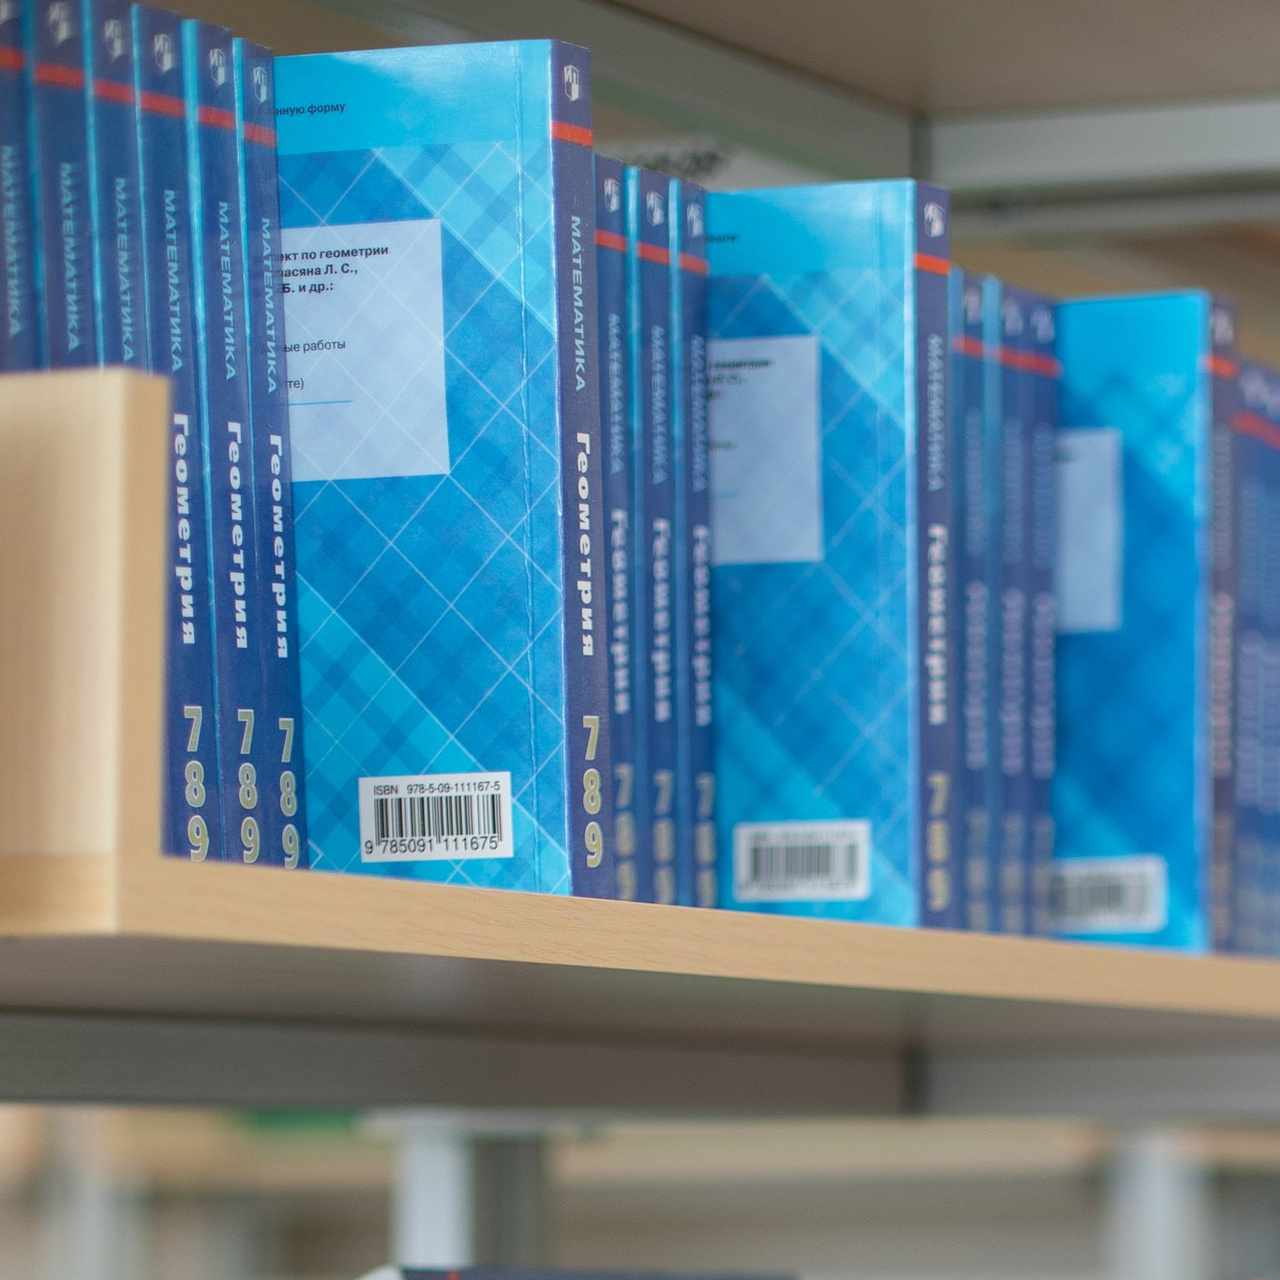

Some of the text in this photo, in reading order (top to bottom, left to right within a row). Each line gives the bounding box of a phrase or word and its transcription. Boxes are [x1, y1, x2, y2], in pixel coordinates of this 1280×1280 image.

[276, 102, 346, 117] нную форму
[302, 250, 315, 261] по
[319, 246, 389, 263] геометрии
[114, 177, 134, 363] МАТЕМАТИКА
[298, 284, 306, 293] и
[284, 340, 346, 354] ые работы
[163, 188, 209, 863] МАТЕМАТИКА Геометрия 7 8 9
[218, 201, 260, 863] МАТЕМАТИКА Геометрия 7 8 9
[261, 217, 299, 870] МАТЕМАТИКА Геометрия 7 8 9
[571, 215, 604, 868] МАТЕМАТИКА Геометрия 7 8 9
[374, 781, 500, 796] ISBN 978-5-09-111167-5
[444, 836, 498, 851] 111675
